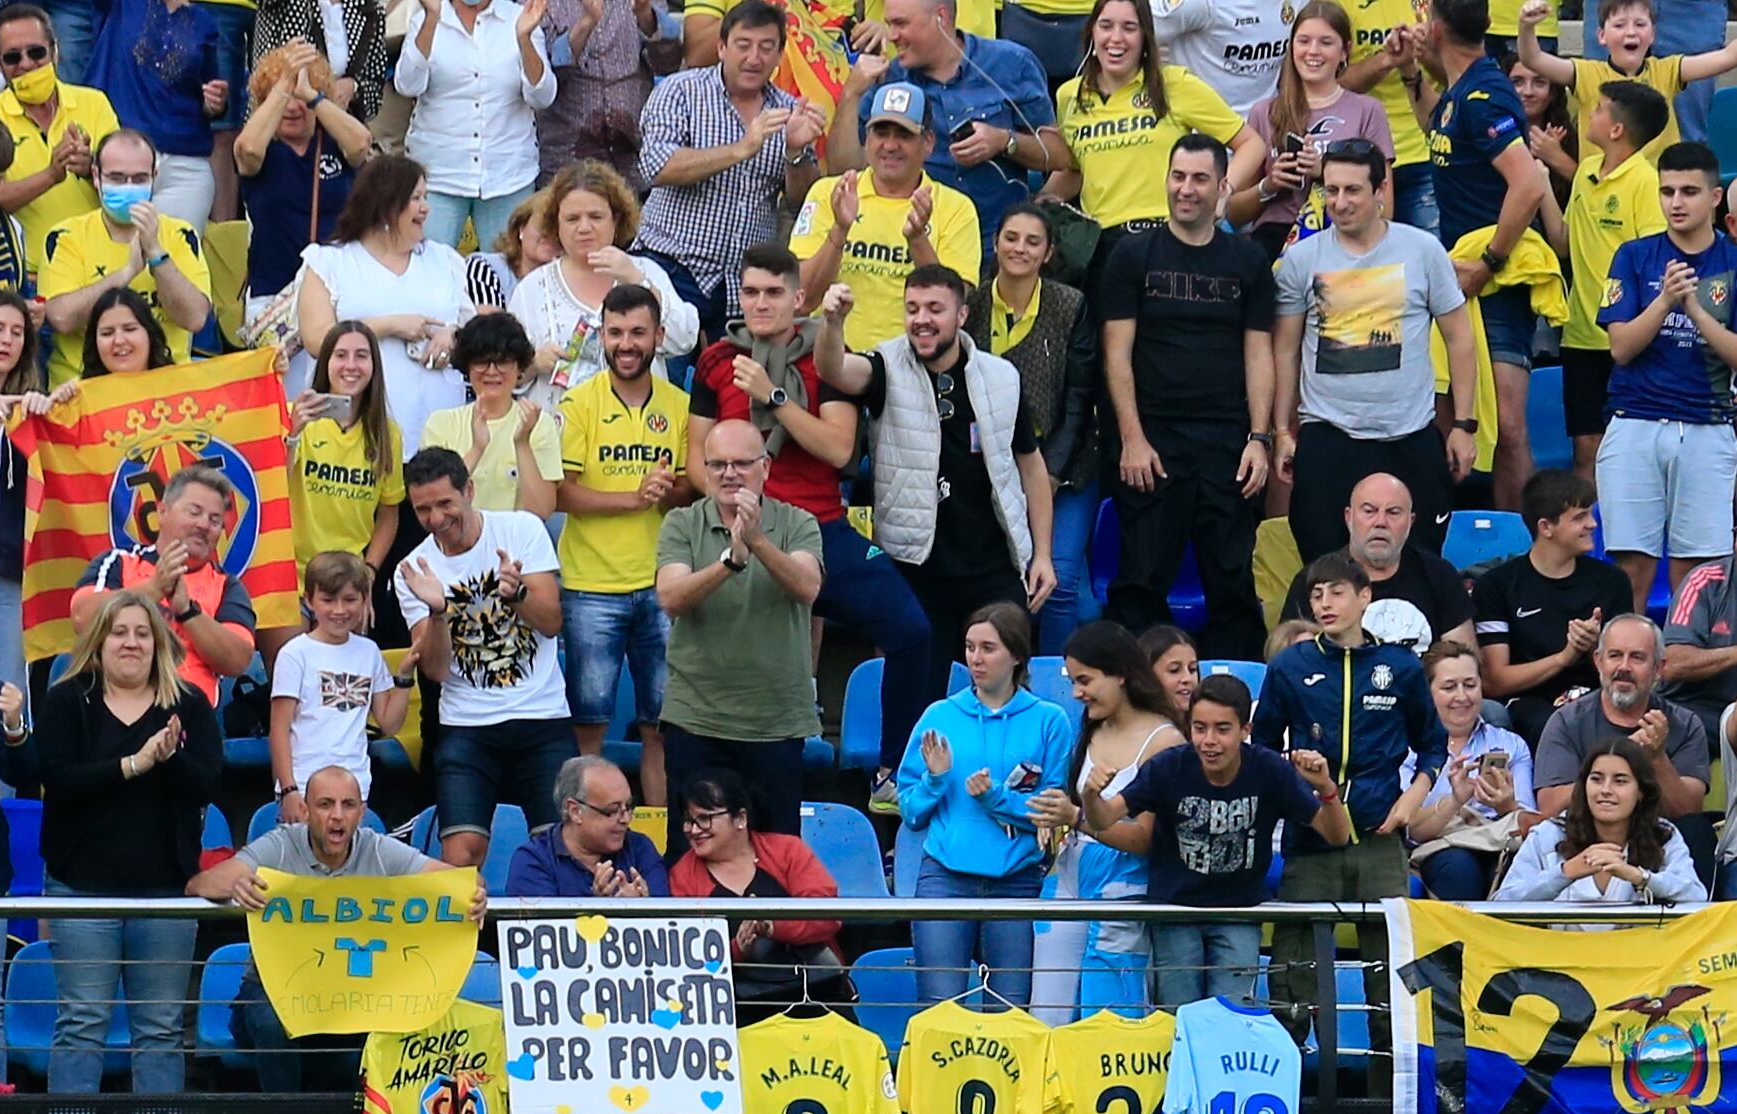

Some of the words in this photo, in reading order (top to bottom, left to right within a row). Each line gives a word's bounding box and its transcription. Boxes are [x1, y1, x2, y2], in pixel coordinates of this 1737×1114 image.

[1224, 38, 1289, 61] PAMES
[842, 240, 914, 265] PAMES
[598, 443, 673, 466] PAMESA
[262, 894, 466, 924] ALBIOL
[510, 979, 560, 1027] LA
[523, 1037, 593, 1082] PER
[609, 1037, 735, 1082] FAVOR
[761, 1056, 852, 1093] M.A.LEAL
[931, 1036, 1022, 1085] S.CAZORLA
[1222, 1052, 1280, 1078] RULLI
